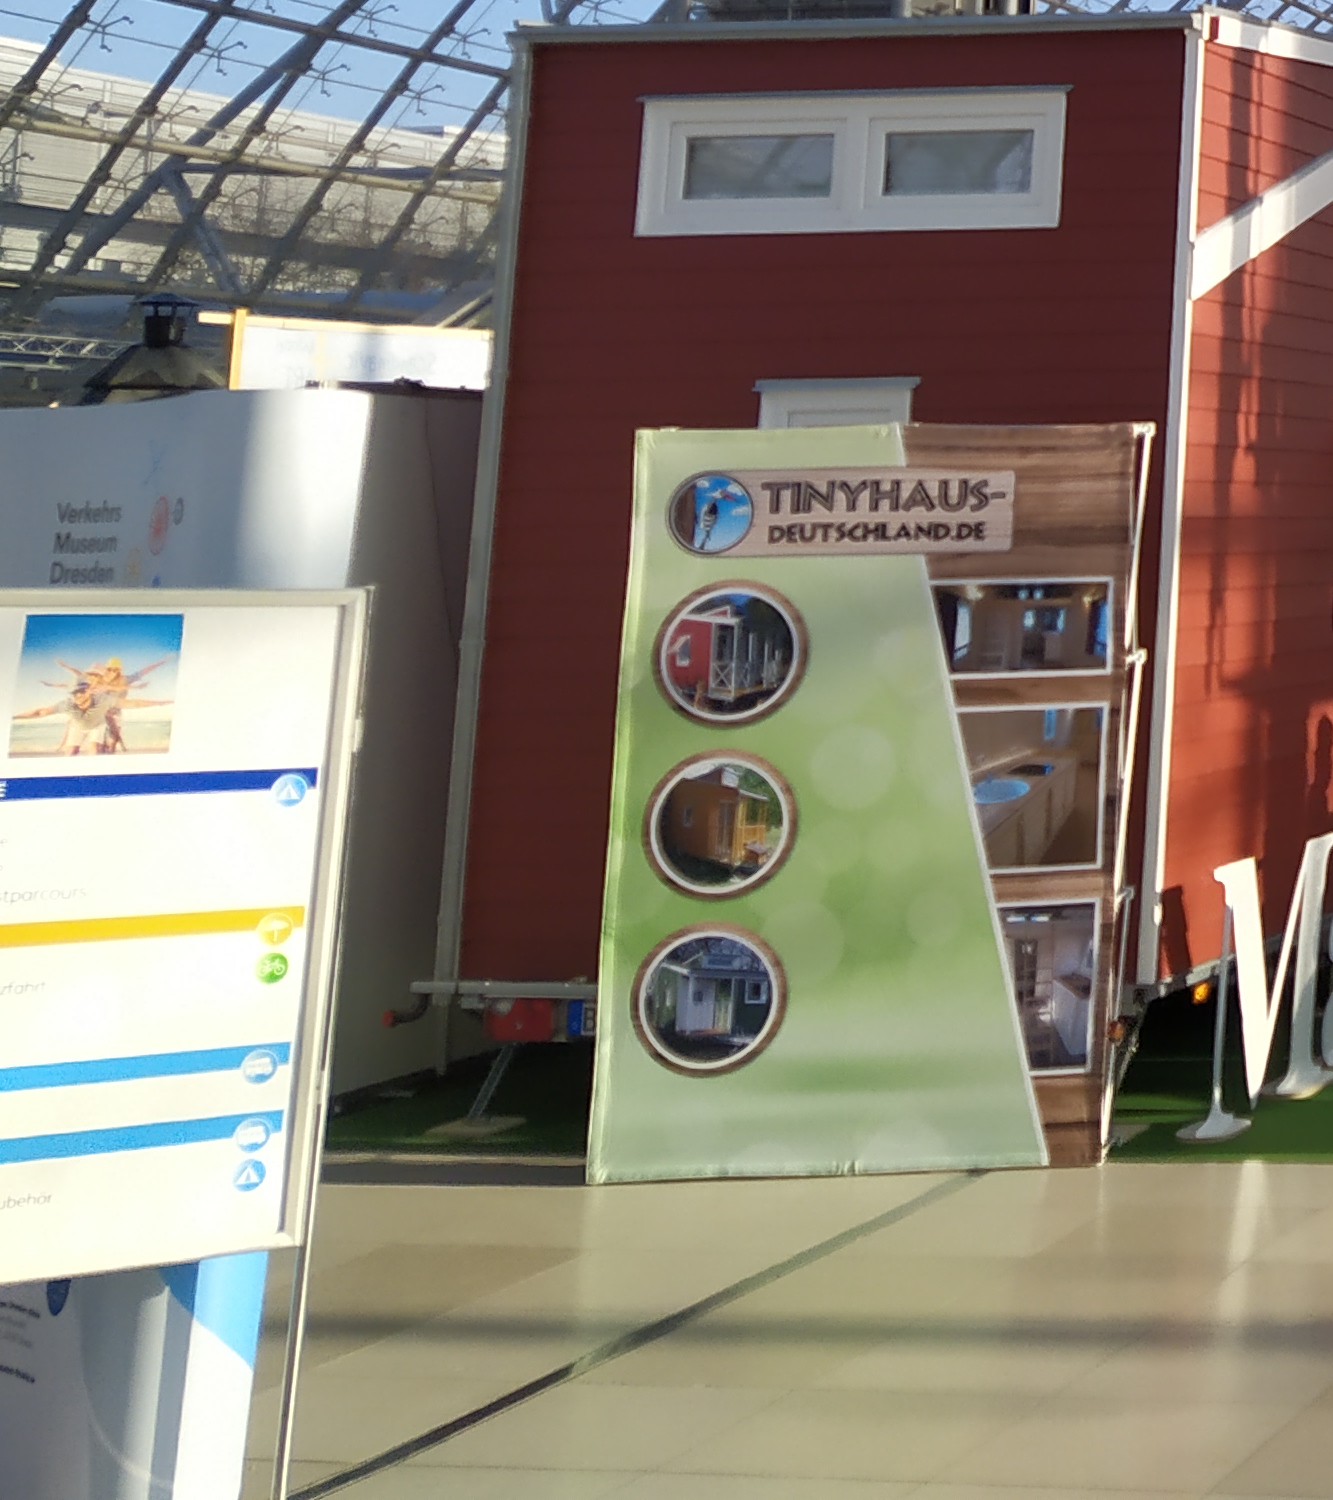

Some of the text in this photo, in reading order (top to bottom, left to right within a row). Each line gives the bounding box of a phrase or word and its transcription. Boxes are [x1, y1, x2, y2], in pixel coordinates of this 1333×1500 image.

[761, 478, 1006, 515] TINYHAUS-
[57, 500, 122, 524] Verkehrs
[53, 531, 118, 554] Museum
[767, 520, 987, 545] DEUTSCHLAND.DE
[49, 560, 115, 585] Dresden
